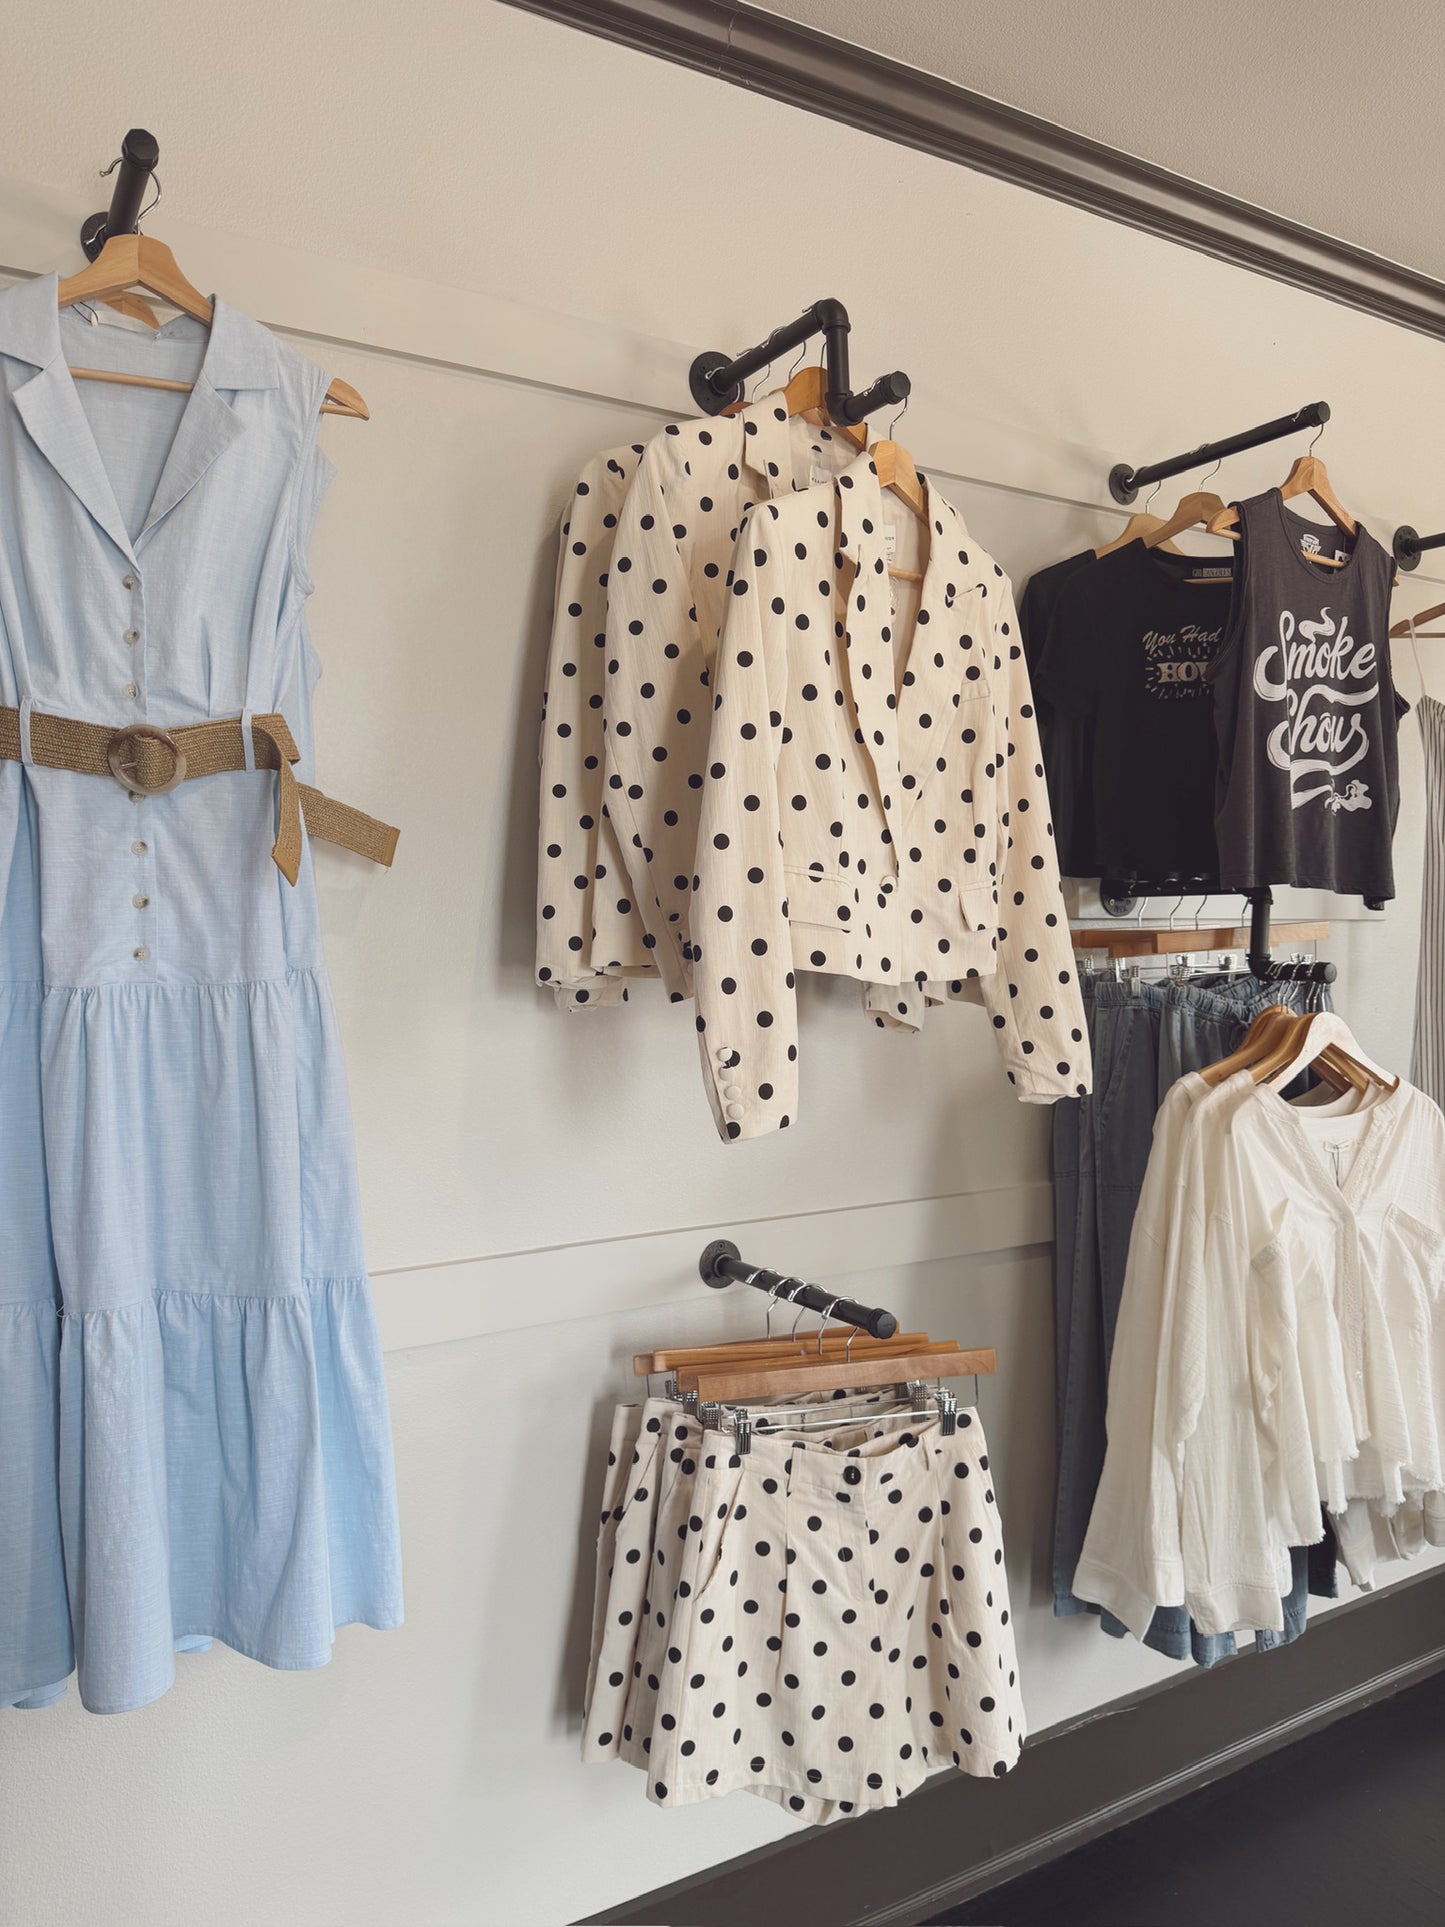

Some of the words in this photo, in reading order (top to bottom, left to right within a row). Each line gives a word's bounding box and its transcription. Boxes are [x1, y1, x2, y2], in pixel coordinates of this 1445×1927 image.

[1142, 631, 1176, 654] You
[1180, 625, 1222, 642] Had
[1254, 608, 1378, 702] Smoke
